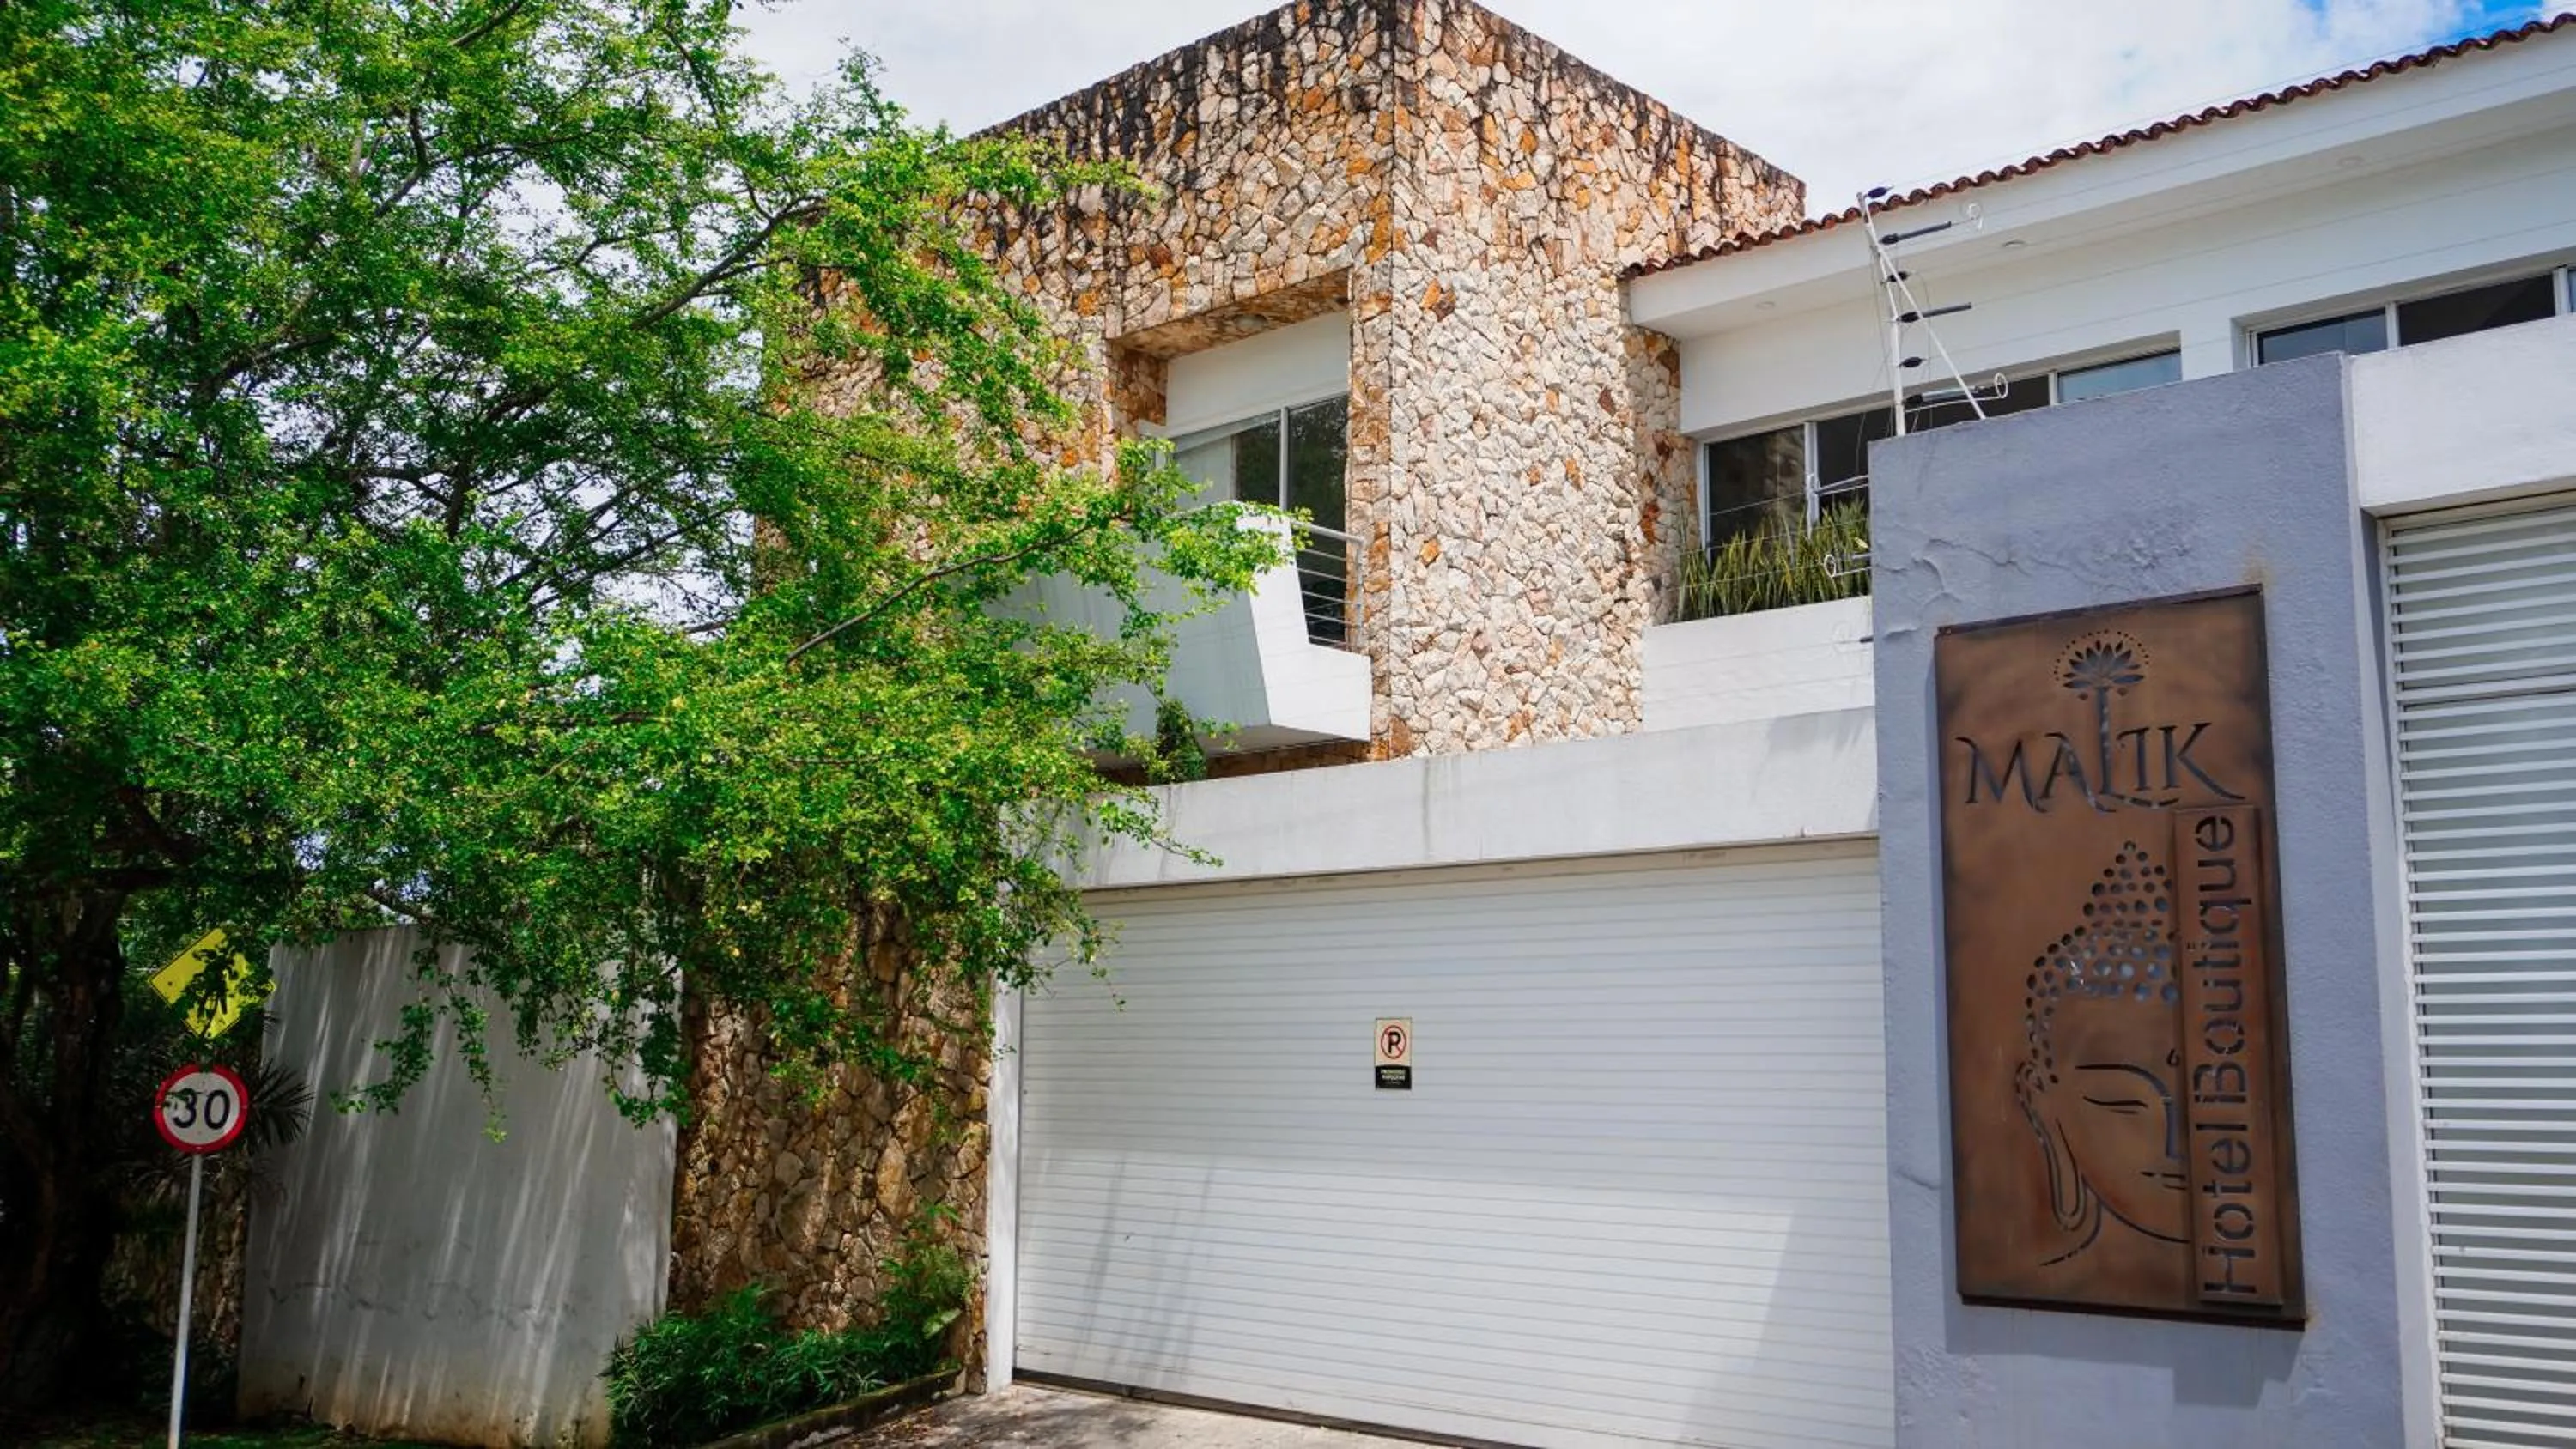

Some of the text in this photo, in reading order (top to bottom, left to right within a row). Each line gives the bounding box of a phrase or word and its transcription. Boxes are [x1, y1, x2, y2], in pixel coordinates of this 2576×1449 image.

[1954, 691, 2246, 814] MALIK
[172, 1088, 231, 1130] 30
[2188, 815, 2257, 1295] Hotel Boutique
